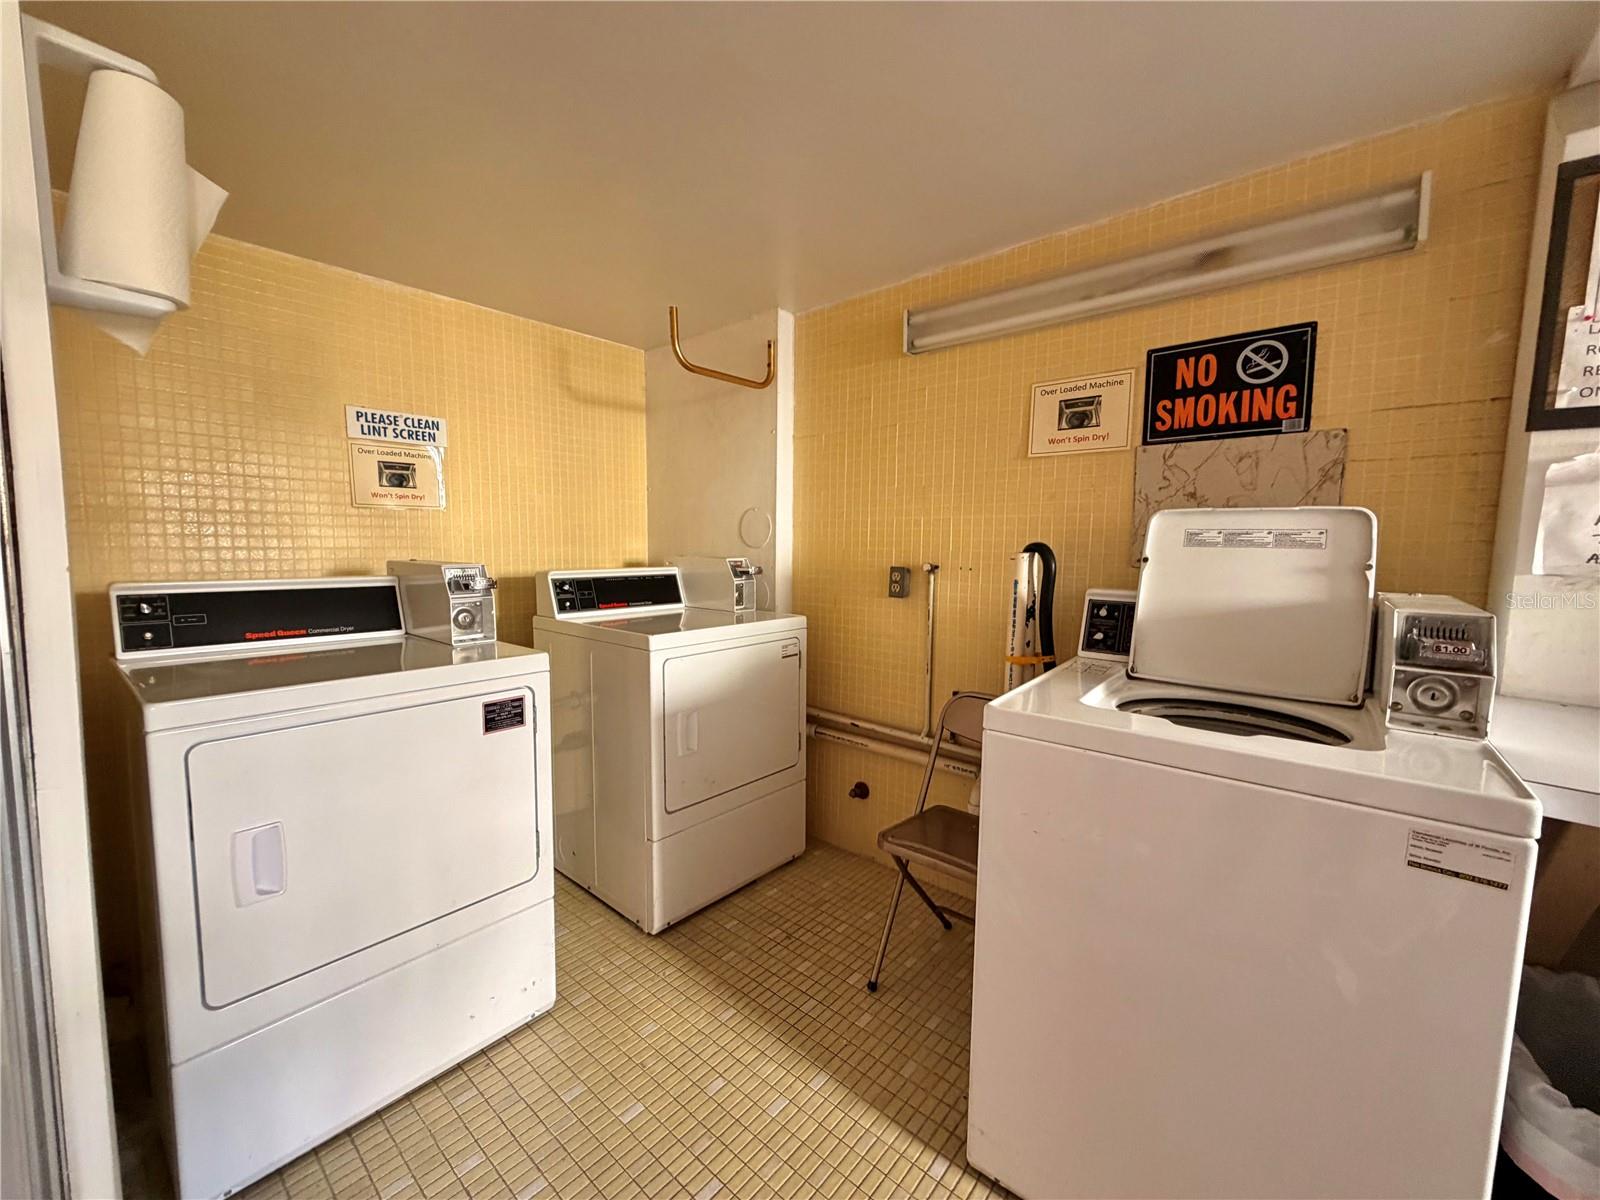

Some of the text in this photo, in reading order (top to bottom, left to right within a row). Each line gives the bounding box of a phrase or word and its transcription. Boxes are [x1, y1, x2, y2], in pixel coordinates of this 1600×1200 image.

[1586, 345, 1600, 355] R
[1175, 353, 1217, 390] NO
[1040, 379, 1124, 397] Over Loaded Machine
[1155, 383, 1298, 431] SMOKING
[356, 411, 439, 431] PLEASE CLEAN
[361, 424, 436, 442] LINT SCREEN
[1048, 432, 1110, 445] Won't Spin Dry!
[357, 447, 432, 460] Over Loaded Machine
[370, 491, 393, 499] Won't
[394, 493, 410, 501] Spin
[245, 630, 276, 639] Speed
[277, 628, 307, 637] Queen
[1434, 645, 1468, 655] $1.00
